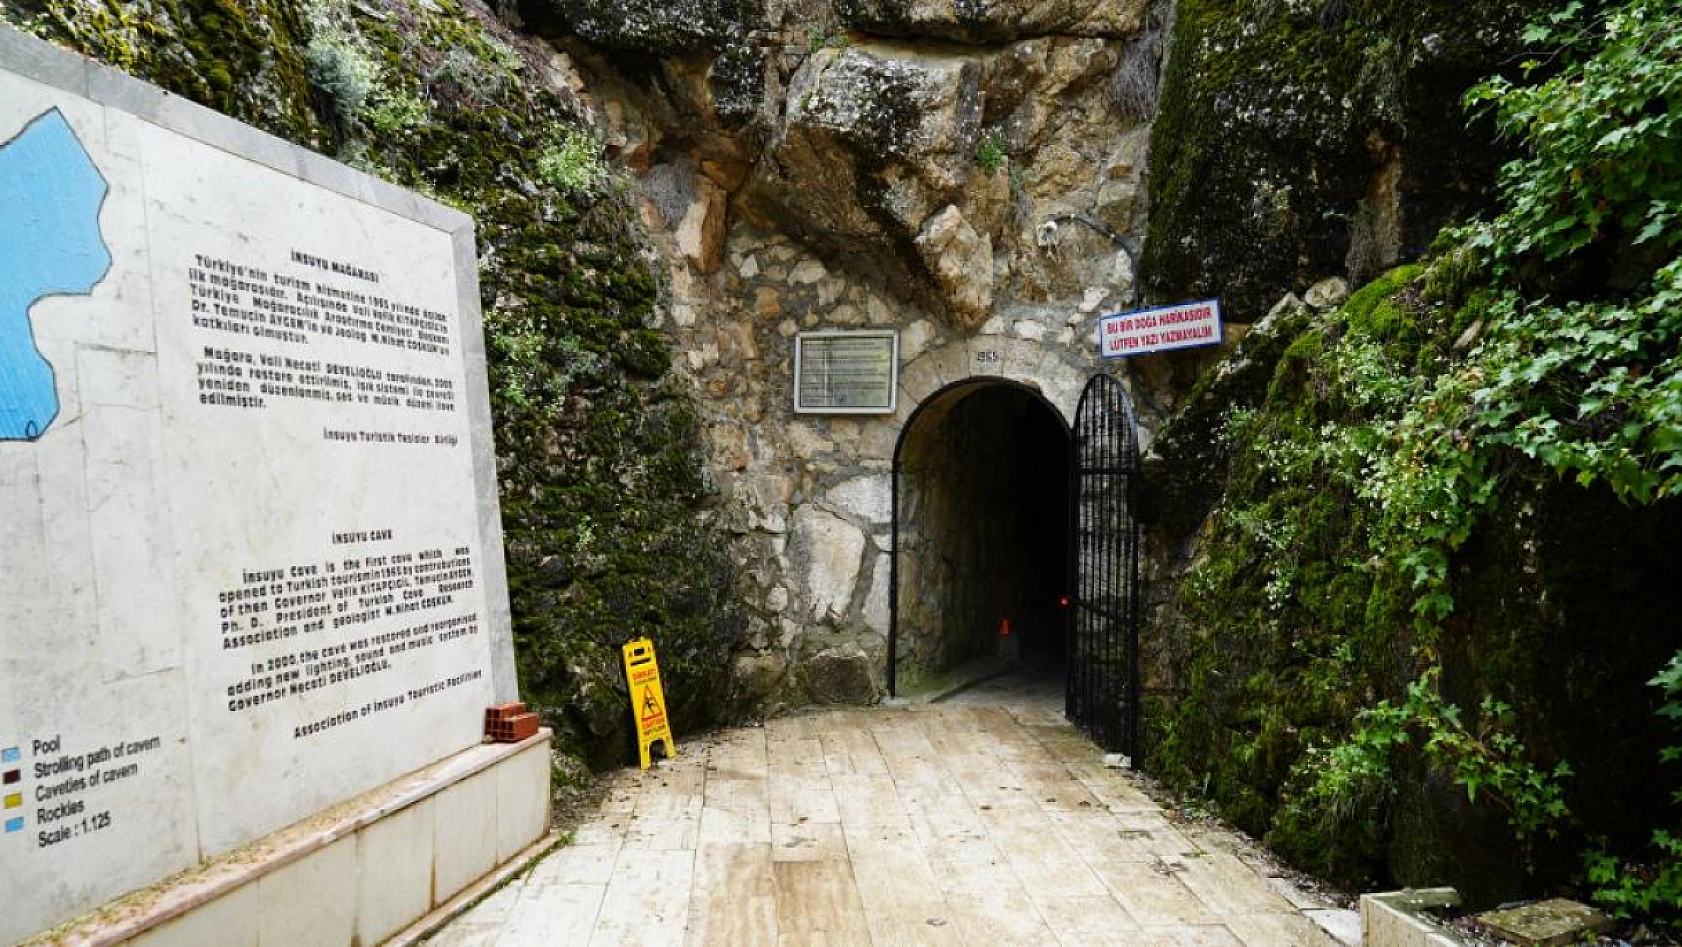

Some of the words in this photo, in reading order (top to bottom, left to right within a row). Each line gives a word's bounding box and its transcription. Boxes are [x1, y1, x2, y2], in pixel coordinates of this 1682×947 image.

[195, 254, 267, 282] Türkiye'nin
[190, 282, 238, 305] Türkiye
[191, 299, 210, 313] Dr.
[320, 325, 333, 336] ve
[352, 304, 370, 317] Vali
[1107, 322, 1118, 335] BU
[1135, 316, 1157, 330] DOĞA
[1110, 335, 1139, 352] LÜTFEN
[1139, 333, 1159, 347] YAZI
[1160, 324, 1213, 343] YAZMAYALIM
[197, 362, 242, 378] yılında
[249, 367, 293, 383] restore
[260, 352, 282, 368] Vali
[285, 358, 321, 372] Necati
[198, 378, 250, 392] yeniden
[358, 394, 369, 404] ve
[358, 430, 395, 443] Turistik
[369, 529, 392, 541] CAVE
[290, 565, 317, 578] Cave
[326, 561, 335, 574] is
[343, 559, 360, 571] the
[366, 556, 387, 567] first
[390, 554, 412, 564] cave
[419, 548, 442, 560] which
[455, 546, 470, 556] was
[219, 584, 267, 603] opened
[270, 583, 283, 596] to
[286, 576, 328, 593] Turkish
[220, 603, 234, 619] of
[238, 599, 267, 617] then
[275, 591, 326, 610] Governor
[221, 618, 244, 635] Ph.
[251, 615, 266, 628] D.
[276, 602, 332, 624] President
[337, 600, 348, 613] of
[358, 592, 394, 608] Turkish
[403, 587, 423, 600] Cave
[223, 625, 297, 650] Association
[303, 617, 325, 633] and
[332, 609, 380, 629] geologist
[300, 648, 319, 664] the
[322, 641, 347, 658] cave
[350, 637, 368, 651] was
[371, 627, 411, 646] restored
[412, 623, 428, 636] and
[227, 675, 273, 698] adding
[275, 669, 300, 683] new
[355, 645, 384, 664] sound
[389, 640, 406, 655] and
[408, 634, 434, 649] music
[438, 627, 467, 643] system
[228, 685, 287, 712] Governor
[289, 675, 326, 695] Necati
[294, 709, 358, 739] Association
[360, 702, 371, 717] of
[408, 680, 445, 701] Touristic
[33, 734, 60, 756] Pool
[34, 755, 84, 780] Strolling
[86, 747, 111, 769] path
[113, 740, 124, 758] of
[126, 736, 161, 755] cavern
[89, 770, 99, 787] of
[103, 763, 138, 783] cavern
[37, 799, 84, 825] Rockies
[38, 826, 71, 848] Scale
